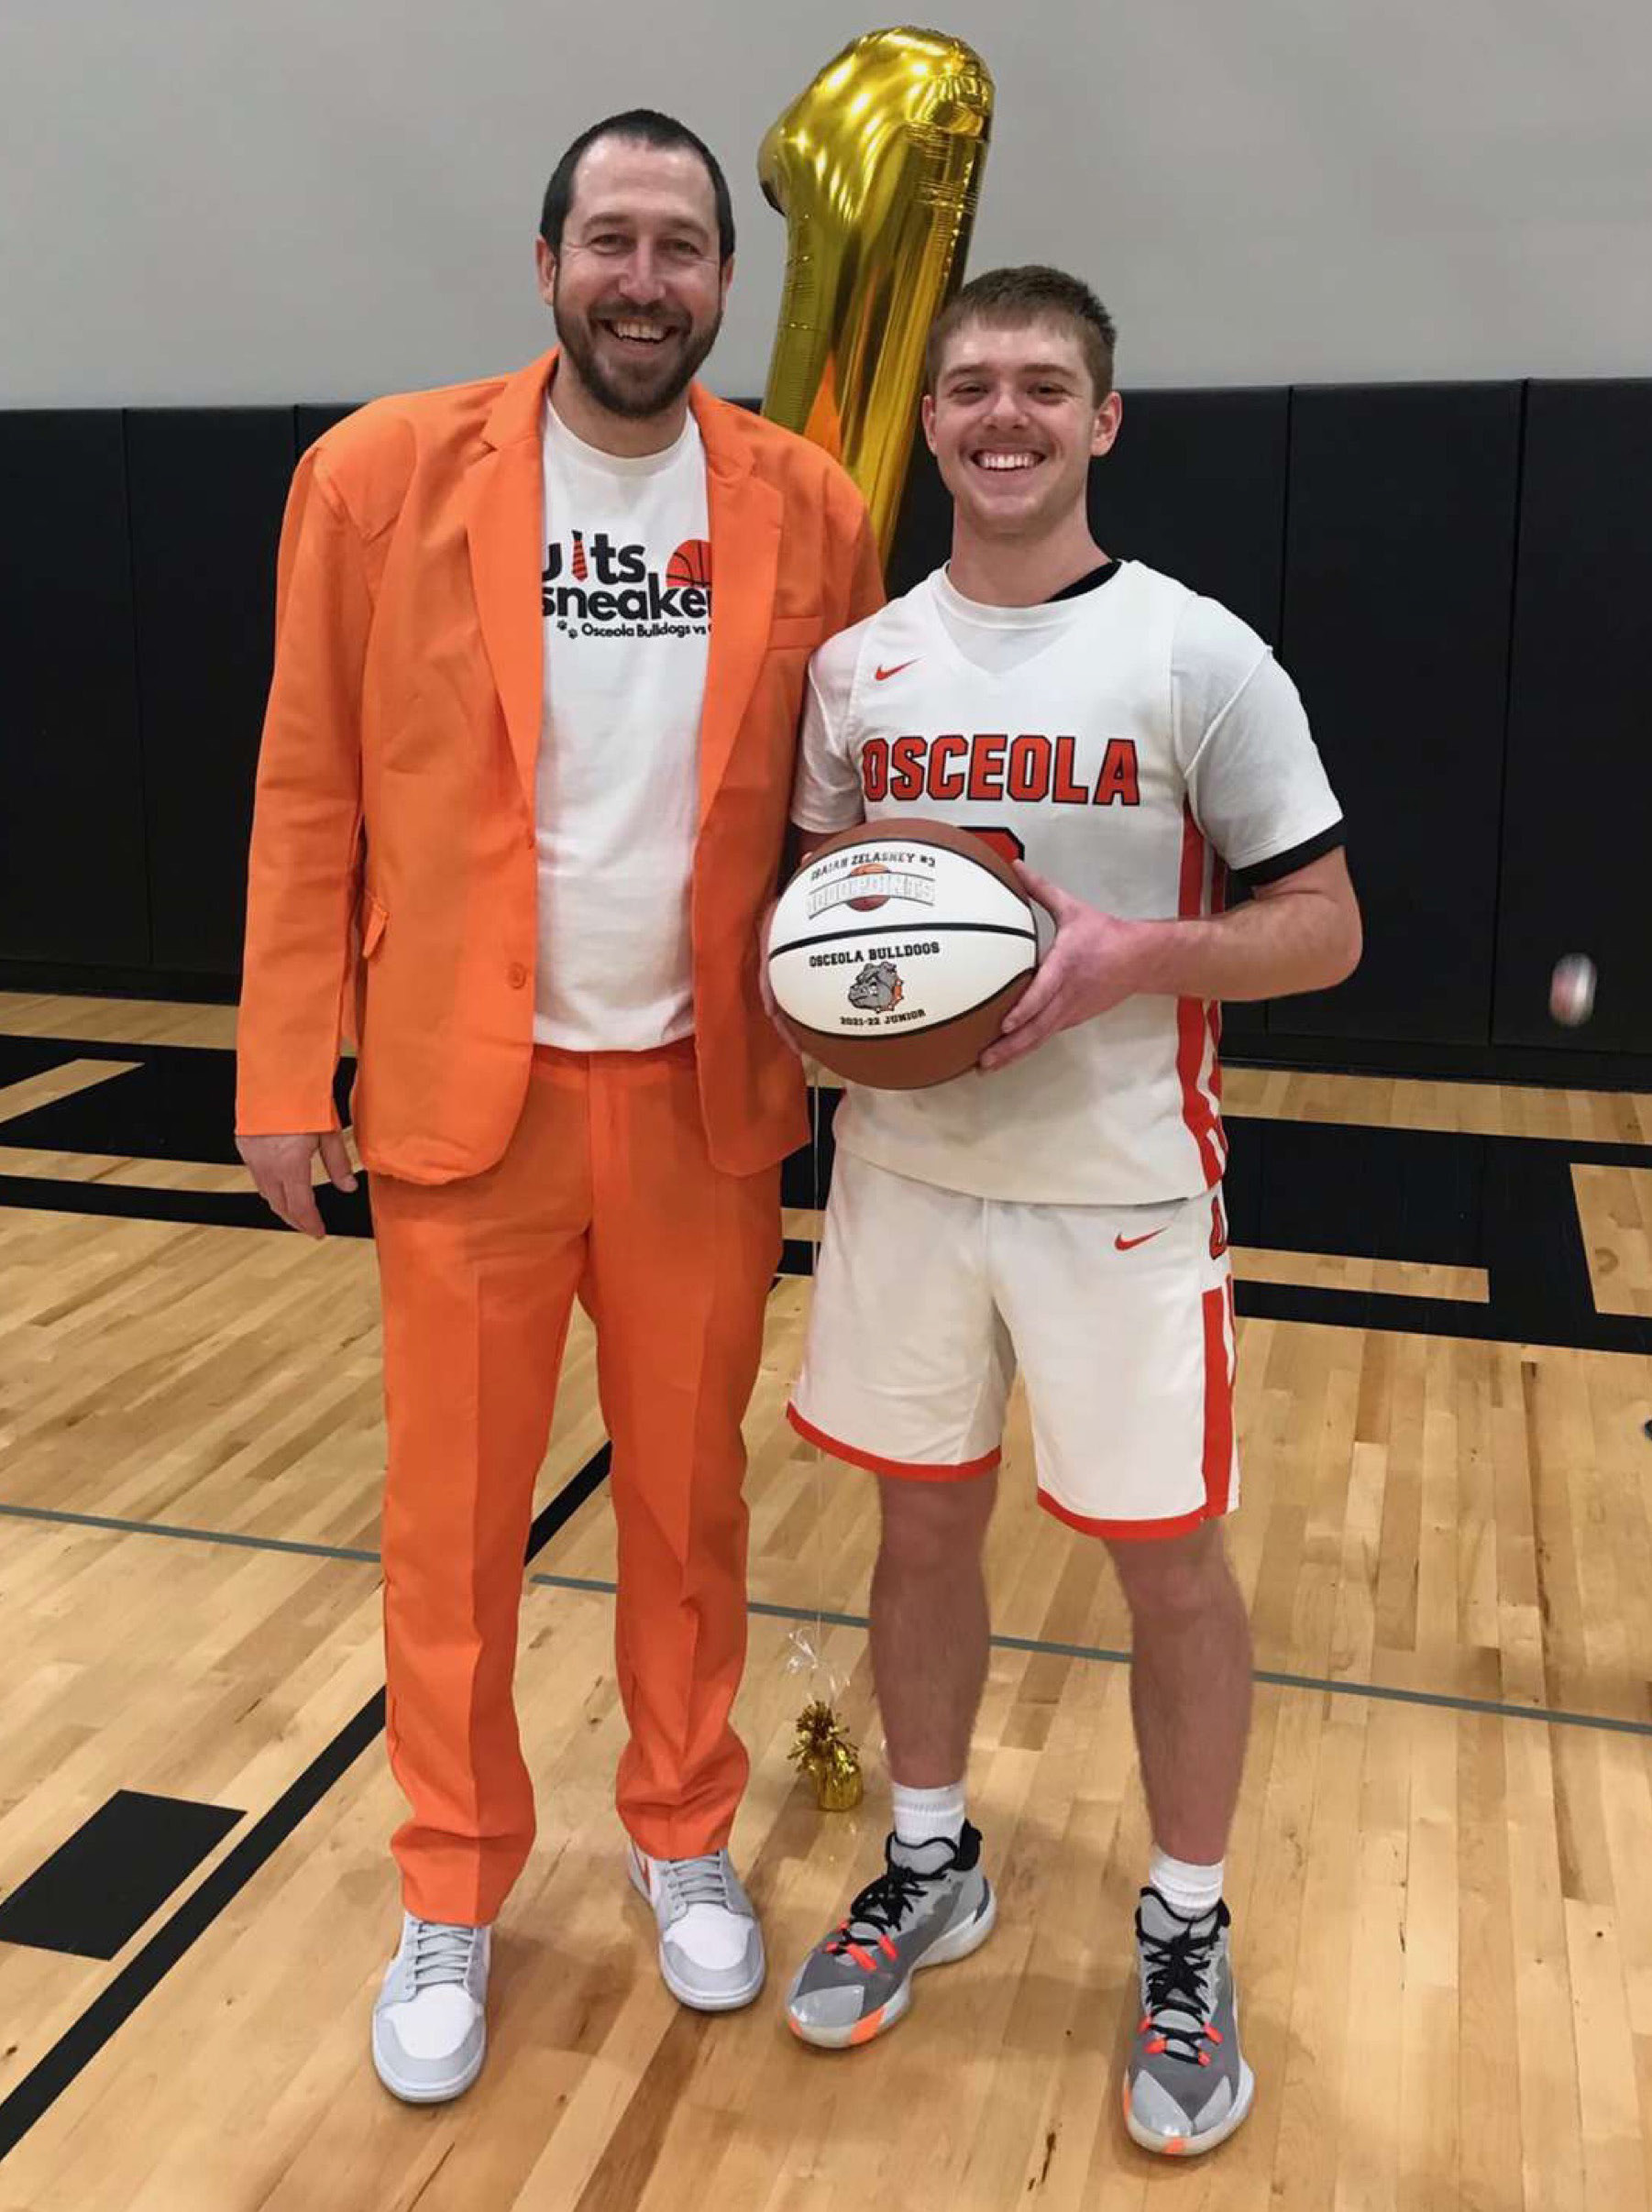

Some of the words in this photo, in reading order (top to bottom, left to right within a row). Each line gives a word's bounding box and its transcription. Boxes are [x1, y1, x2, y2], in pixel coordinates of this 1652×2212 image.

[581, 622, 634, 638] Osceola
[636, 622, 690, 638] Bulldogs
[862, 734, 1140, 806] OSCEOLA
[809, 950, 865, 967] OSCEOLA
[868, 941, 941, 961] BULLDOGS
[883, 1008, 927, 1025] JUNIOR
